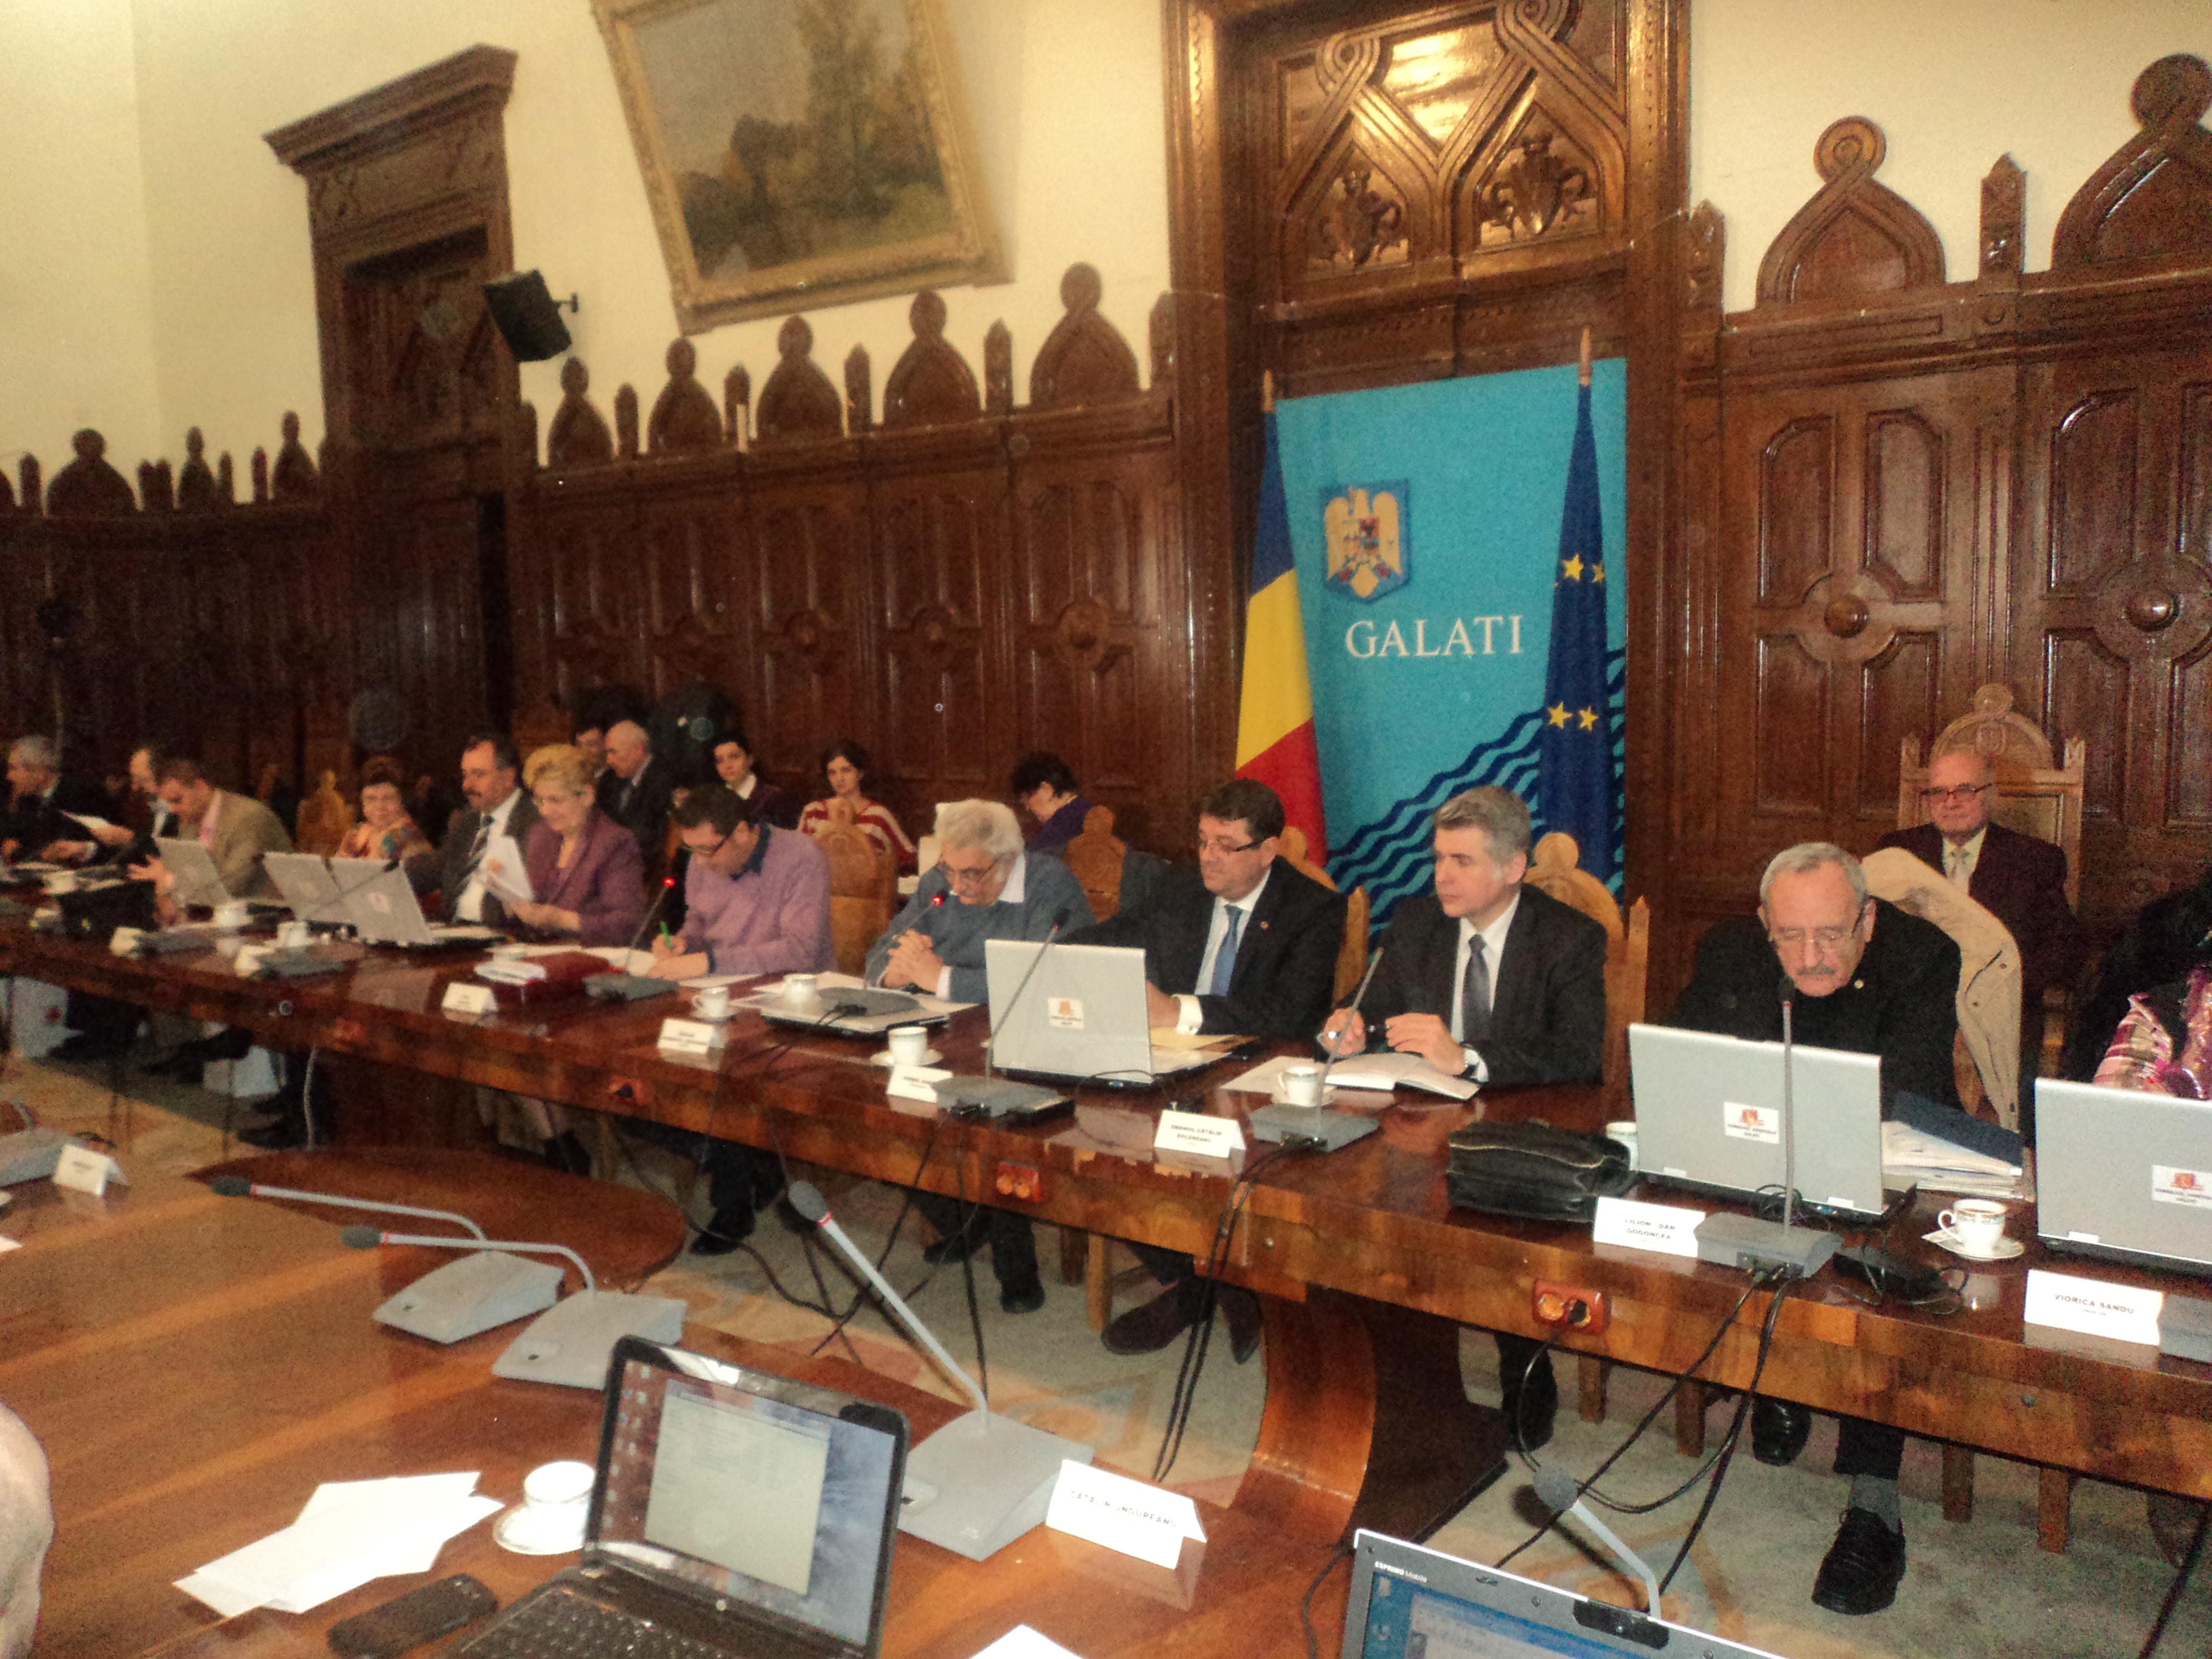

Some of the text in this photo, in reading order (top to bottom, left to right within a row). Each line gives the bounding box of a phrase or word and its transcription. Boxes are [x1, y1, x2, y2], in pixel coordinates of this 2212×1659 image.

[1346, 615, 1524, 658] GALATI
[1626, 1228, 1671, 1239] GOGONCEA
[2054, 1294, 2095, 1307] VIORICA
[2100, 1302, 2134, 1314] SANDU
[1375, 1561, 1427, 1583] ESPRIMO Mobile
